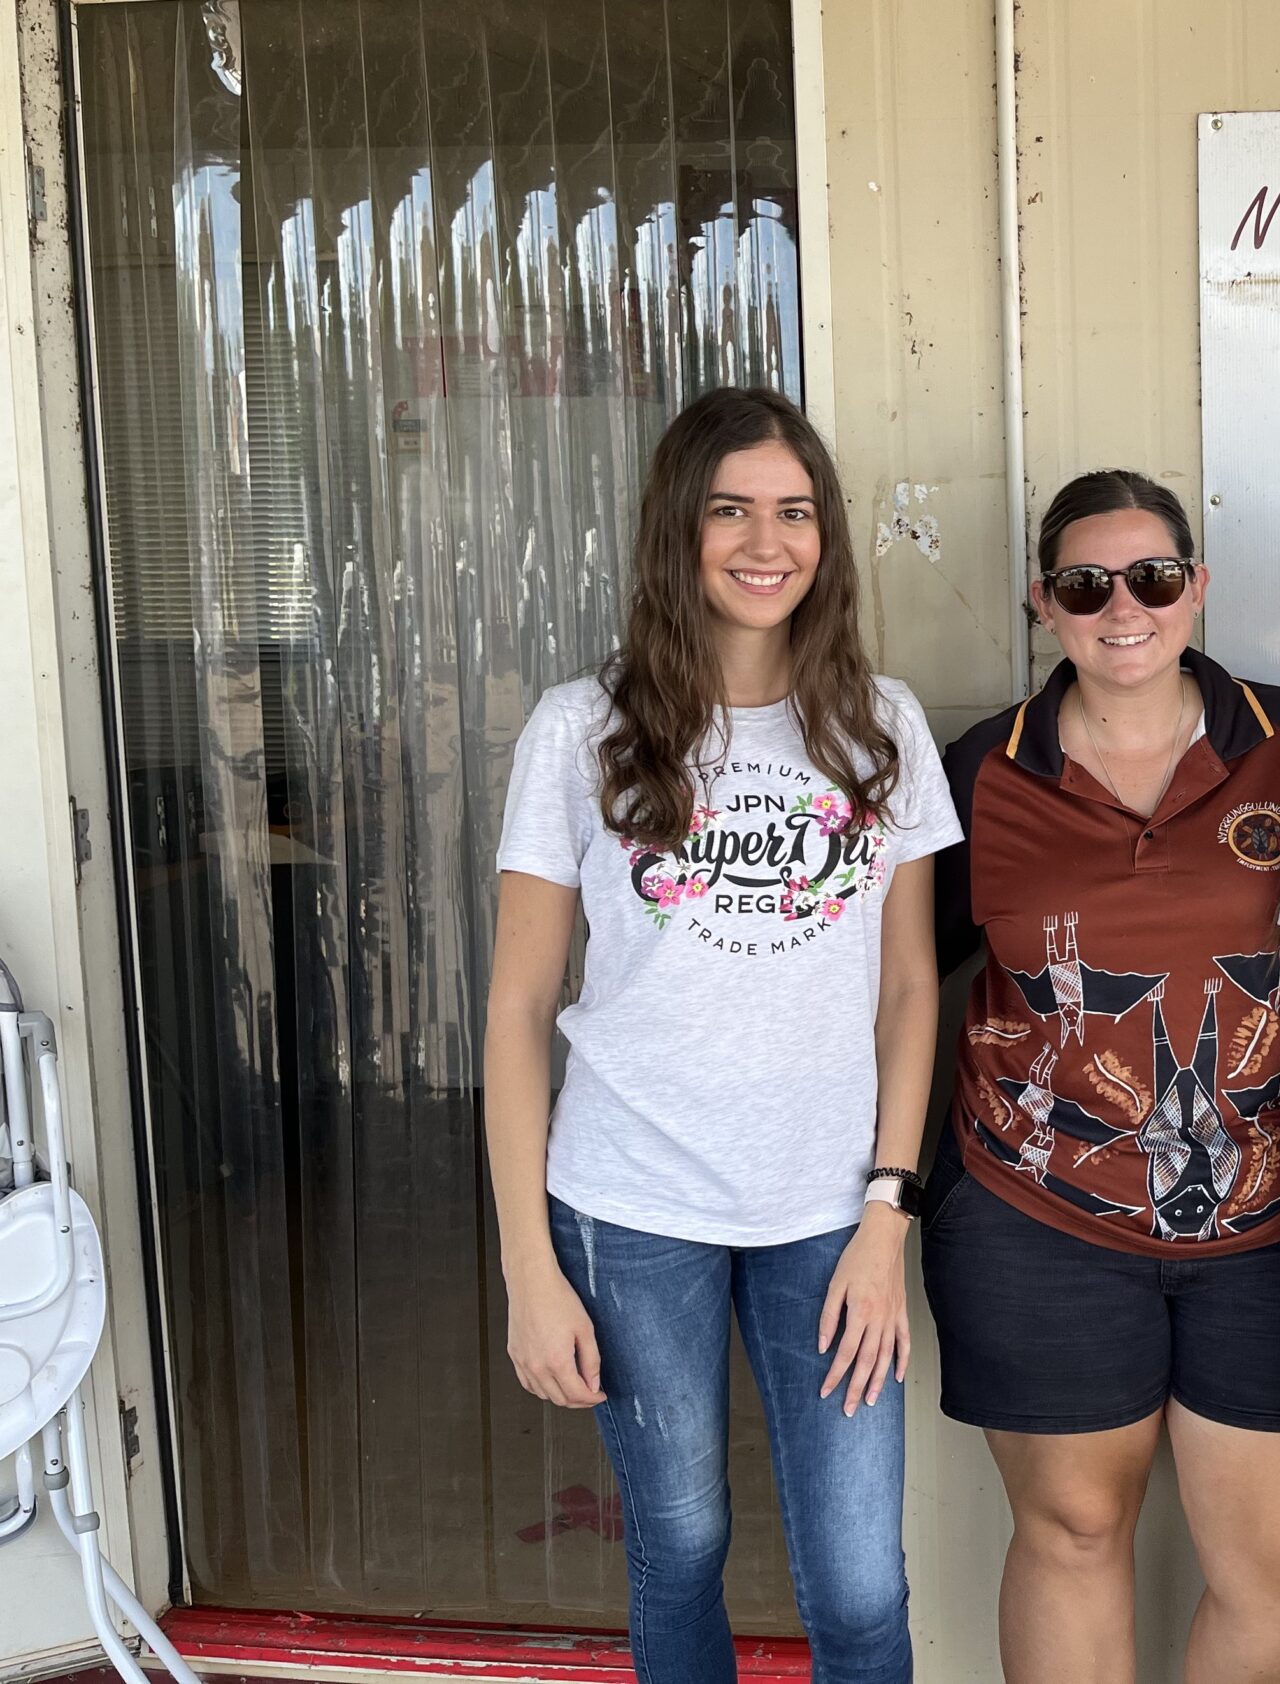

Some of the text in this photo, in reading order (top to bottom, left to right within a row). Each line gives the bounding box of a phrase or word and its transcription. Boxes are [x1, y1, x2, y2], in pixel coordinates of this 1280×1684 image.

[698, 762, 811, 786] PREMIUM
[726, 795, 786, 813] JPN
[687, 917, 831, 956] TRADE MARK
